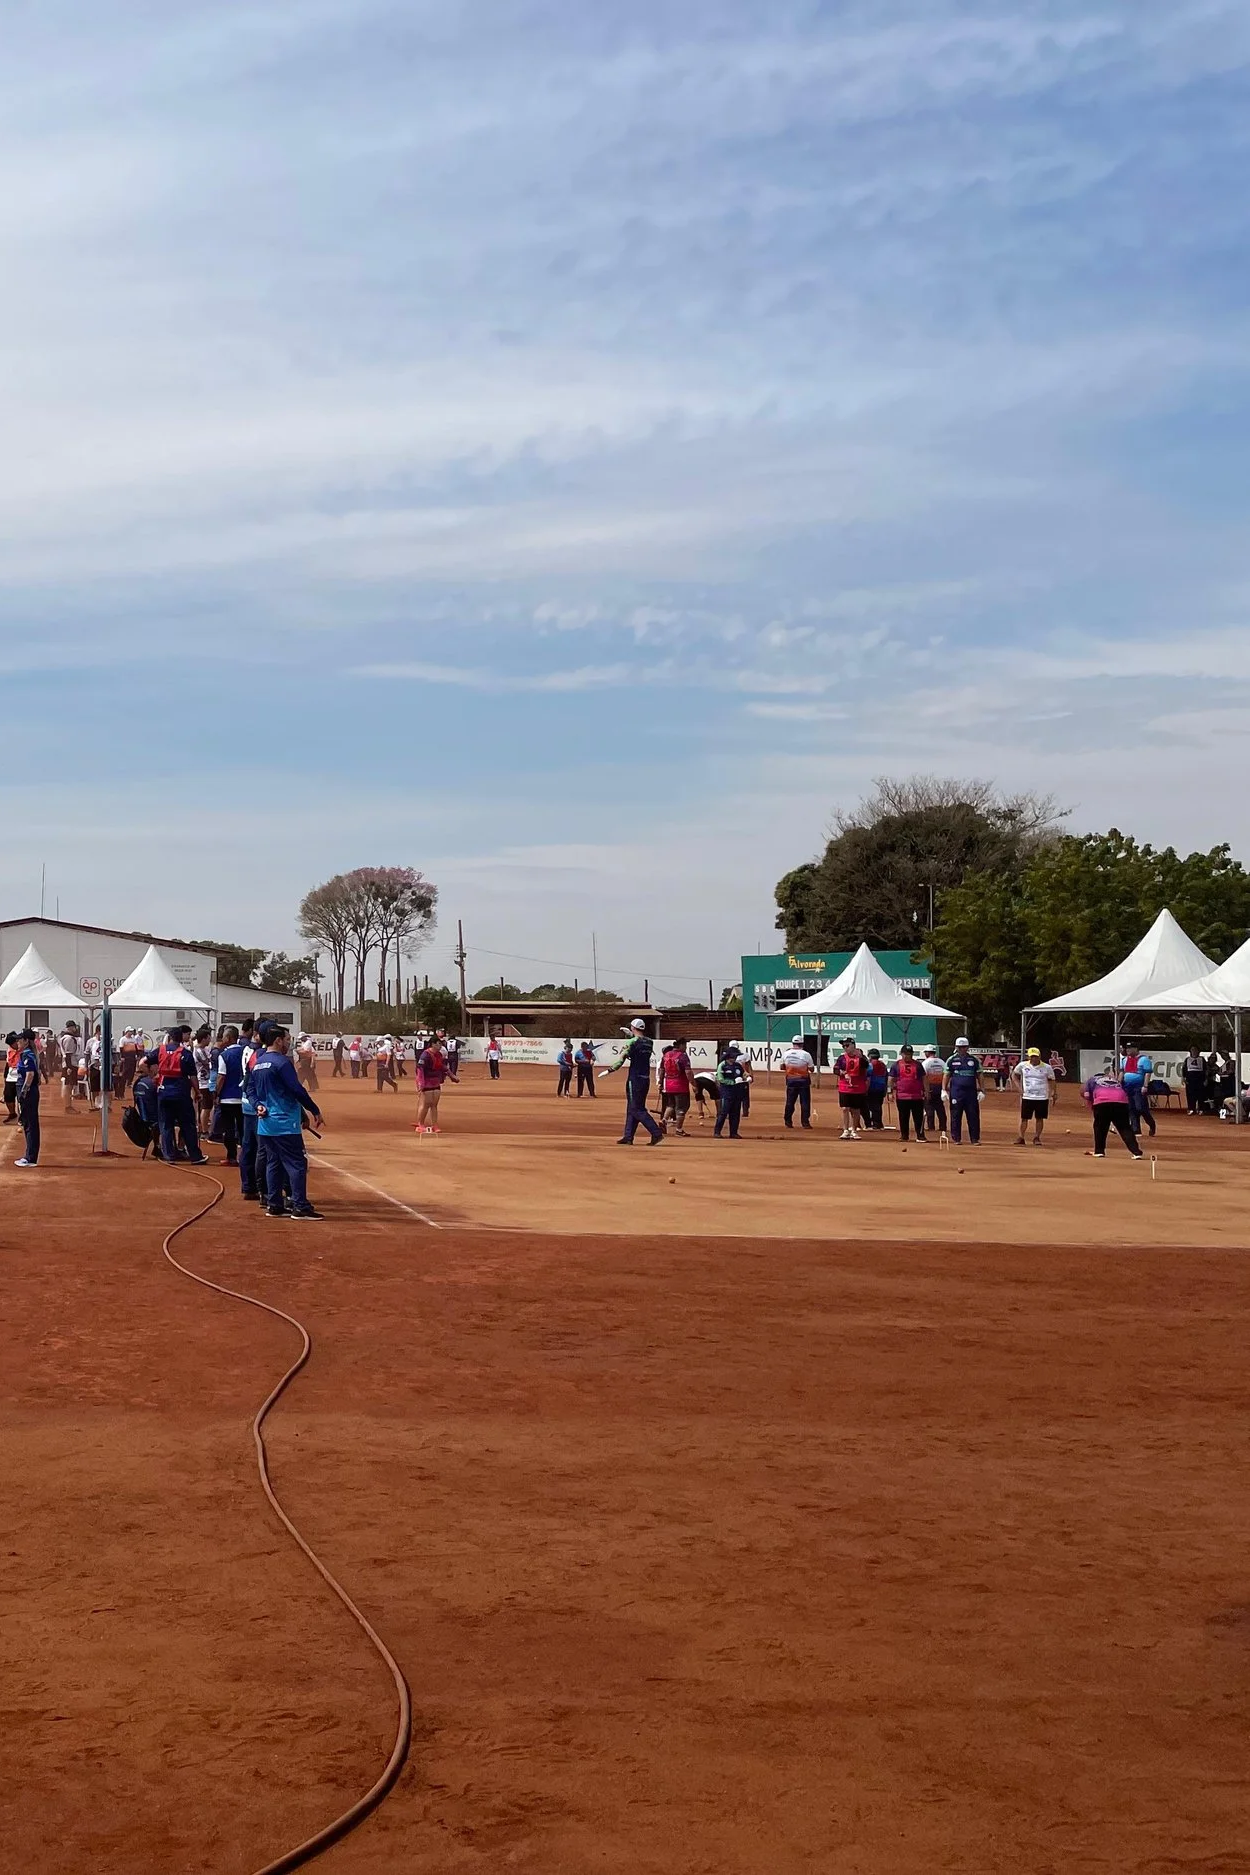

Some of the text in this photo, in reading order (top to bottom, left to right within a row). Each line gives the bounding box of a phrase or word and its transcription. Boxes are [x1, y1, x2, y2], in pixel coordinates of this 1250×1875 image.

[775, 979, 800, 989] EQUIPE
[809, 980, 815, 989] 2
[817, 980, 823, 989] 3
[903, 979, 912, 988] 13
[921, 979, 929, 988] 15
[905, 1065, 911, 1074] 5
